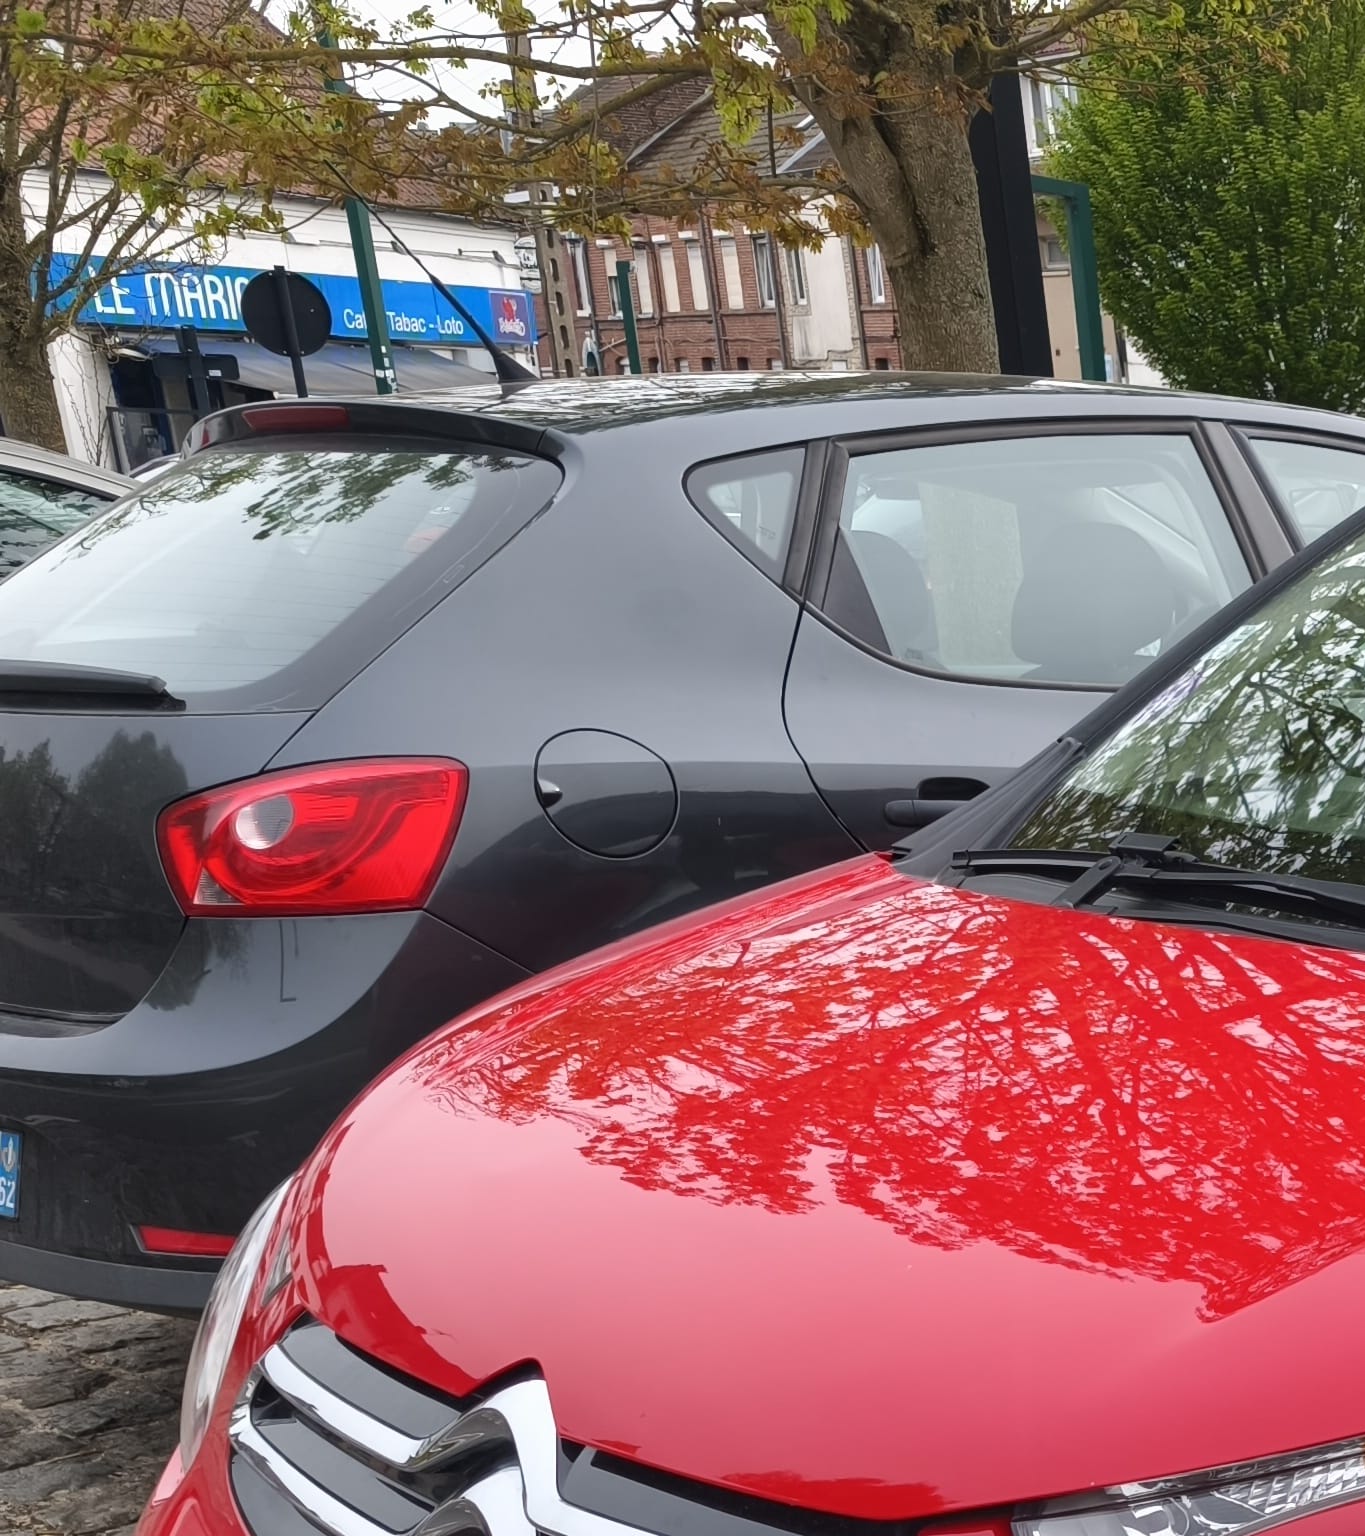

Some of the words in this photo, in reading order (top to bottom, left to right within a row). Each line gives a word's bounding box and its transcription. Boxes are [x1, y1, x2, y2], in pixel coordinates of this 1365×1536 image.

[88, 266, 136, 314] LE
[386, 311, 426, 333] Tabac
[437, 314, 464, 335] Loto
